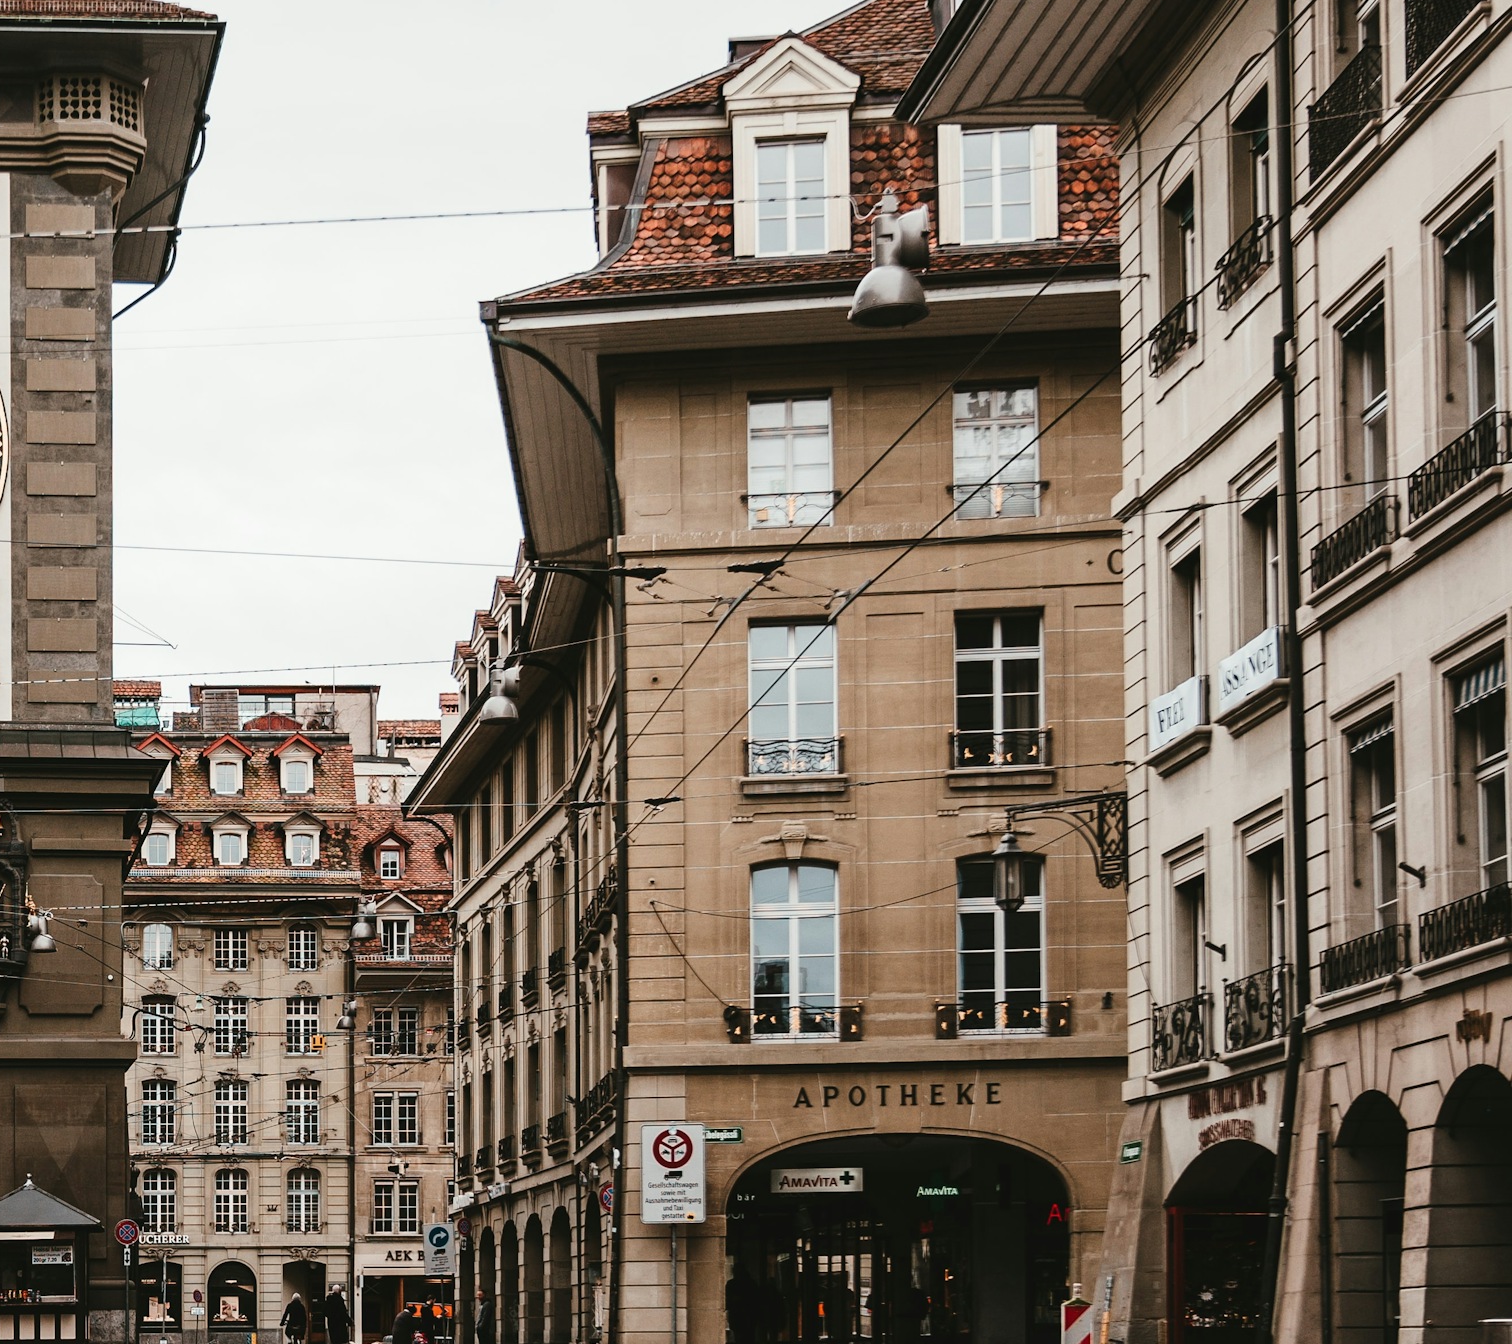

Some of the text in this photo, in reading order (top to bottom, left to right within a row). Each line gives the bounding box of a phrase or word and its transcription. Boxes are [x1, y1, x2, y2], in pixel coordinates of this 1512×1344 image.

[1220, 642, 1274, 701] ASSANGE
[1157, 697, 1185, 734] FREE
[792, 1082, 1002, 1108] APOTHEKE
[704, 1129, 739, 1140] ibelegässli
[779, 1175, 838, 1190] AMAVITA
[916, 1185, 959, 1198] AMAVITA
[645, 1197, 702, 1205] Ausnahmebewilligung
[138, 1234, 190, 1245] UCHERER
[385, 1250, 413, 1262] AEK
